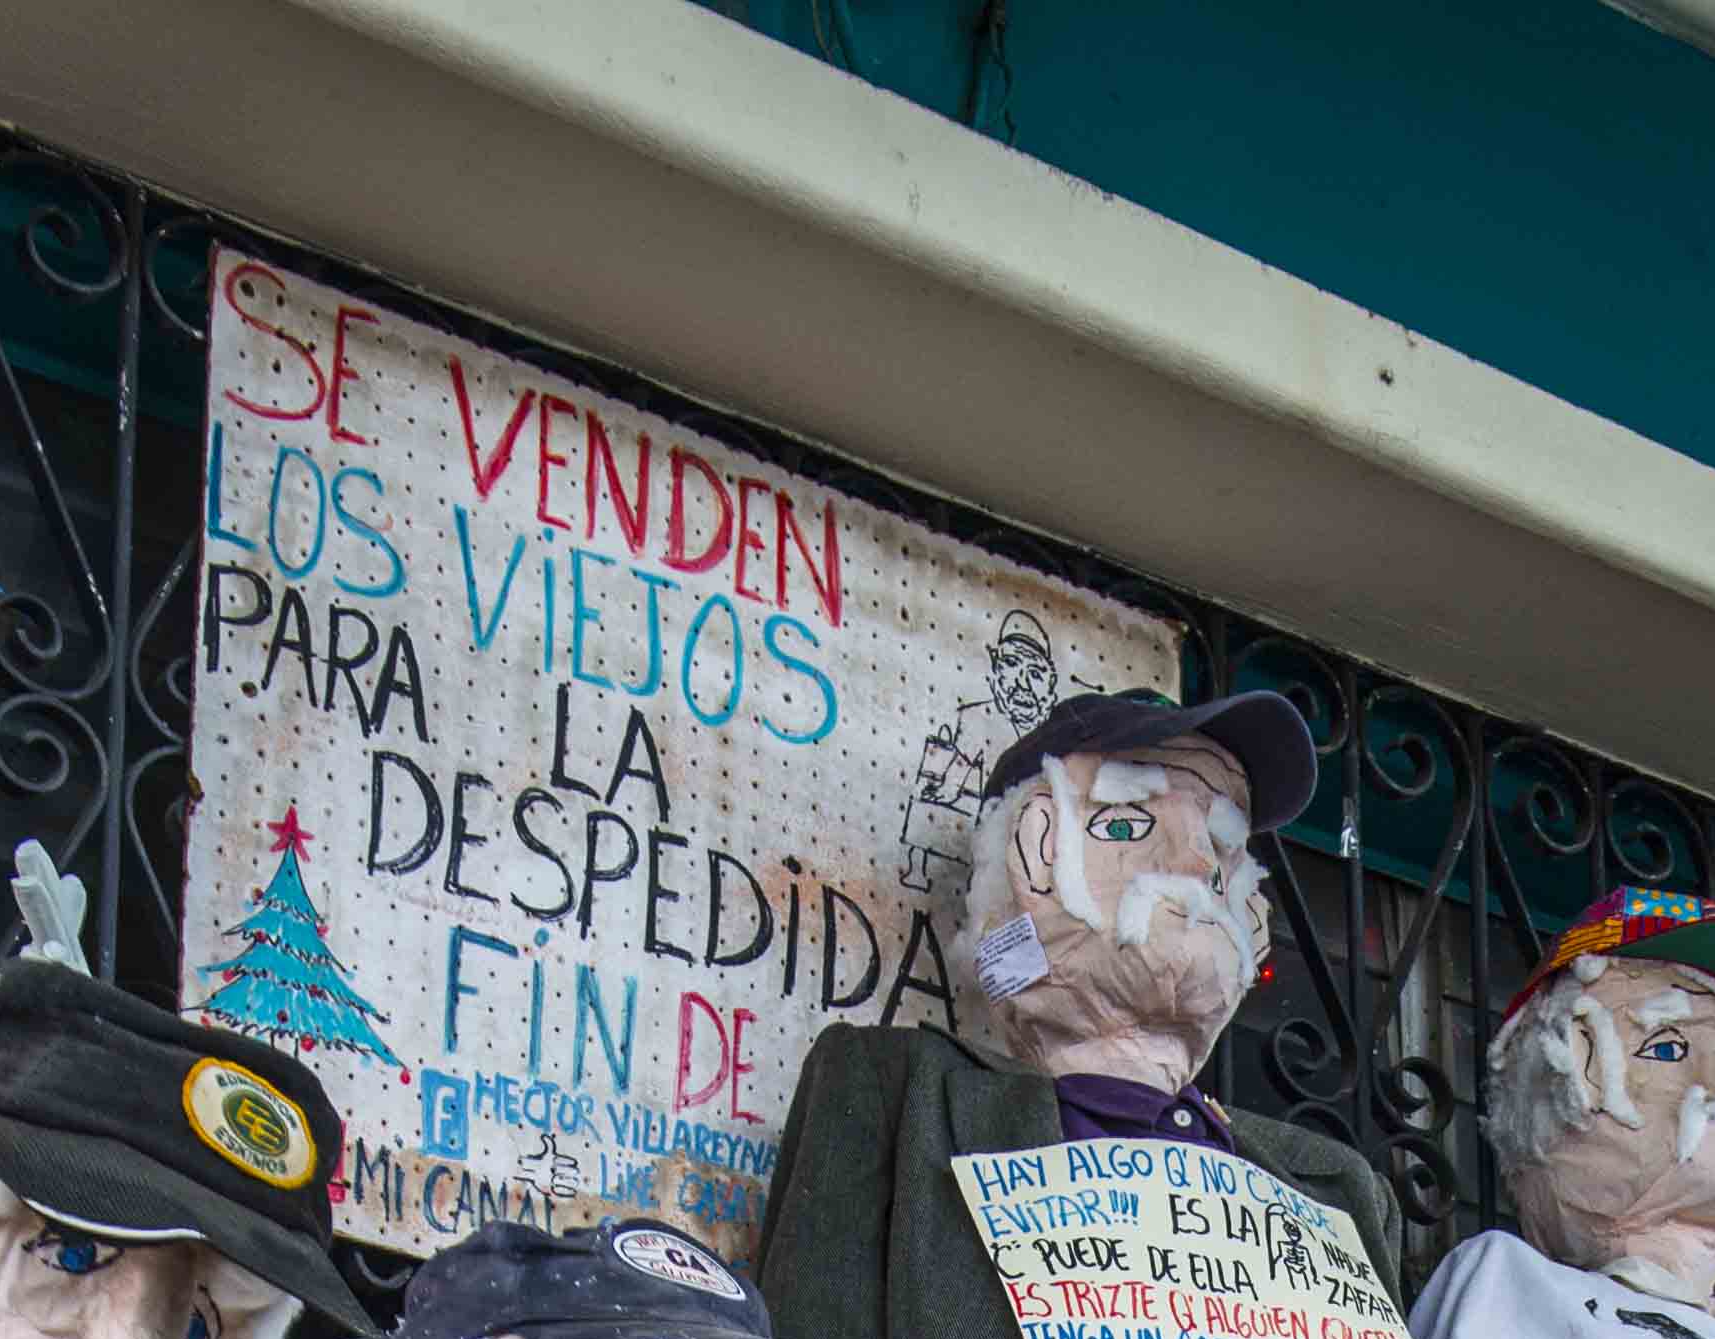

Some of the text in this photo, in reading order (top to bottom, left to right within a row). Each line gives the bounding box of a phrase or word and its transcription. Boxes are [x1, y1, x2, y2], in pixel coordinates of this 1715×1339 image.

[225, 262, 842, 628] SE VENDEN
[207, 423, 407, 598] LOS
[204, 564, 671, 822] PARA LA
[674, 990, 764, 1125] DE
[473, 1071, 602, 1144] HECTOR
[972, 1157, 1045, 1200] HAY
[1069, 1143, 1154, 1182] ALGO
[1199, 1154, 1237, 1196] NO
[1170, 1194, 1211, 1237] ES
[1221, 1193, 1262, 1247] LA
[1008, 1280, 1059, 1320] ES
[1039, 1236, 1131, 1276] PUEDE
[1148, 1244, 1182, 1283] DE
[1189, 1252, 1260, 1302] ELLA
